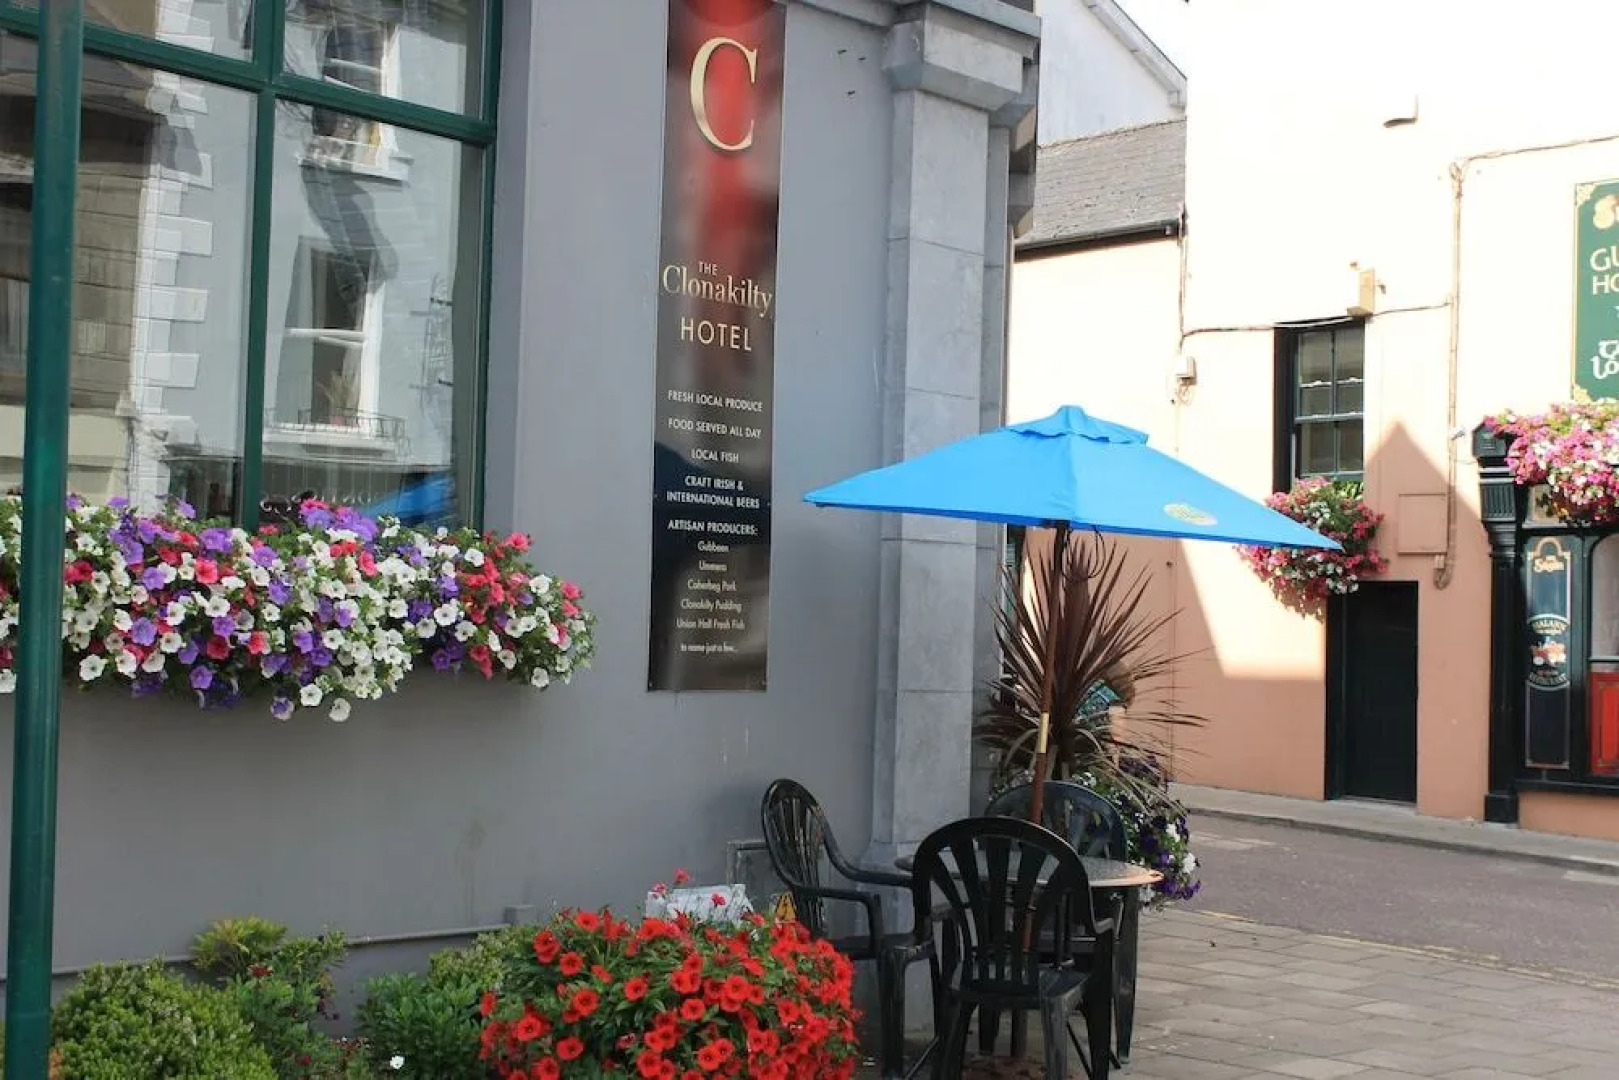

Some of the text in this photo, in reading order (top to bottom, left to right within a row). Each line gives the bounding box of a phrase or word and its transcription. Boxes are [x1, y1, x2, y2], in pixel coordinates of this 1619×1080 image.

[690, 36, 758, 152] C
[699, 261, 718, 276] THE
[662, 264, 773, 318] Clonakilty
[680, 317, 752, 351] HOTEL
[668, 390, 763, 412] FRESH LOCAL PRODUCE
[668, 418, 762, 439] FOOD SERVED ALL DAY
[691, 448, 739, 463] LOCAL FISH
[685, 475, 744, 492] CRAFT IRISH &
[666, 491, 760, 509] INTERNATIONAL BEERS
[667, 519, 758, 536] ARTISAN PRODUCERS:
[716, 598, 742, 614] Pudding
[676, 618, 696, 629] Union
[714, 618, 730, 630] Fresh
[732, 618, 745, 630] Fish
